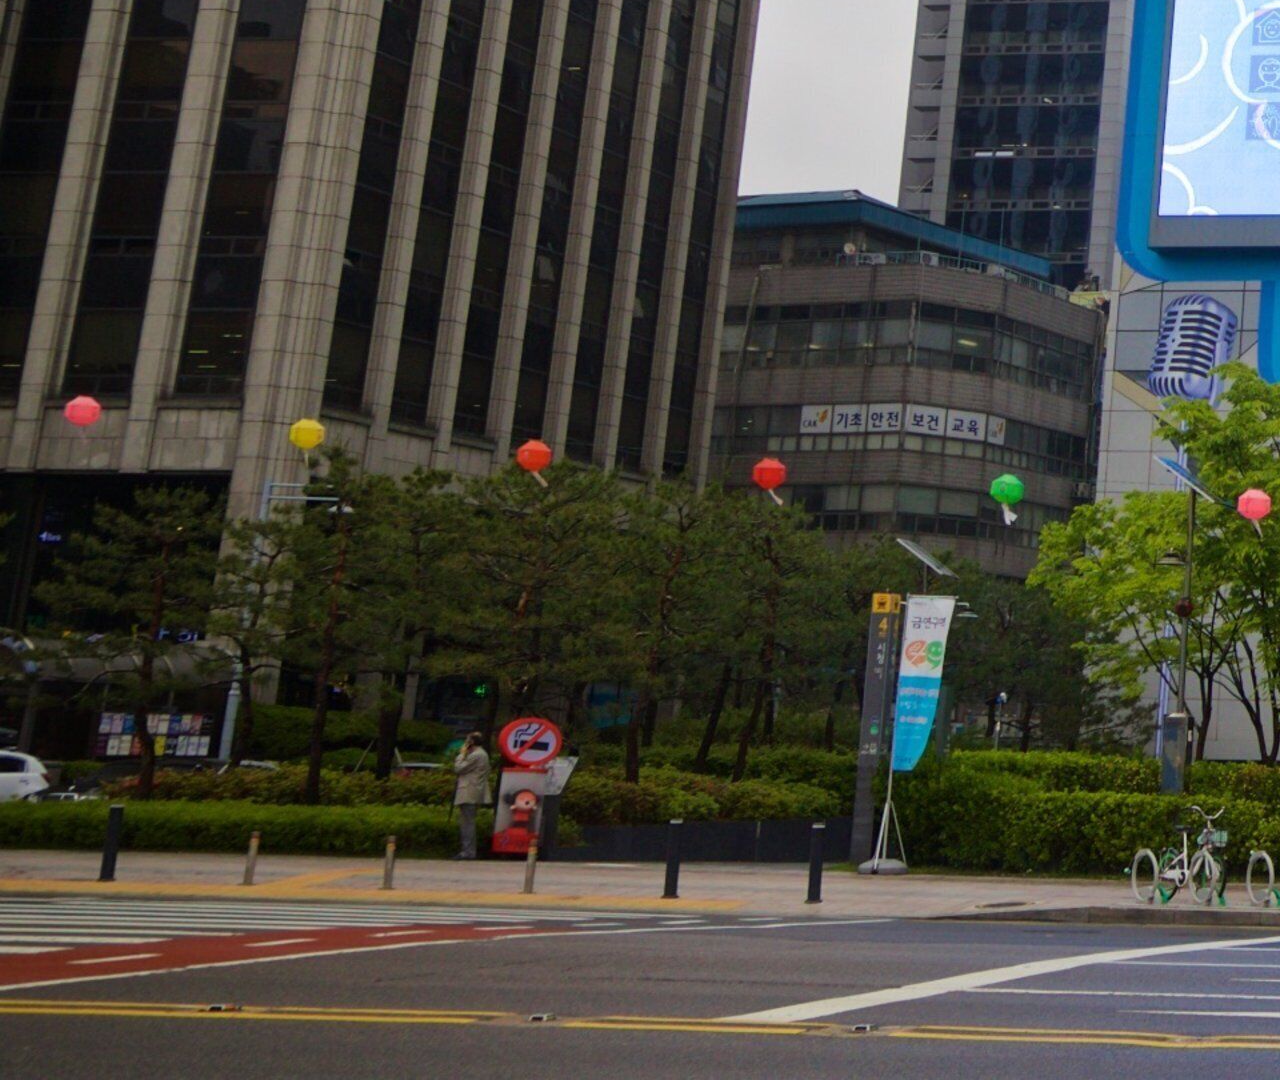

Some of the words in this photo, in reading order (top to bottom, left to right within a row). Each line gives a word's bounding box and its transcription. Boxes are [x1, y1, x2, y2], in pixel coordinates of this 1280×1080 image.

[836, 412, 863, 429] 기초
[871, 411, 900, 429] 안전
[911, 413, 940, 432] 보건
[951, 419, 980, 436] 교육
[878, 616, 888, 631] 4
[911, 616, 947, 630] 금연구역
